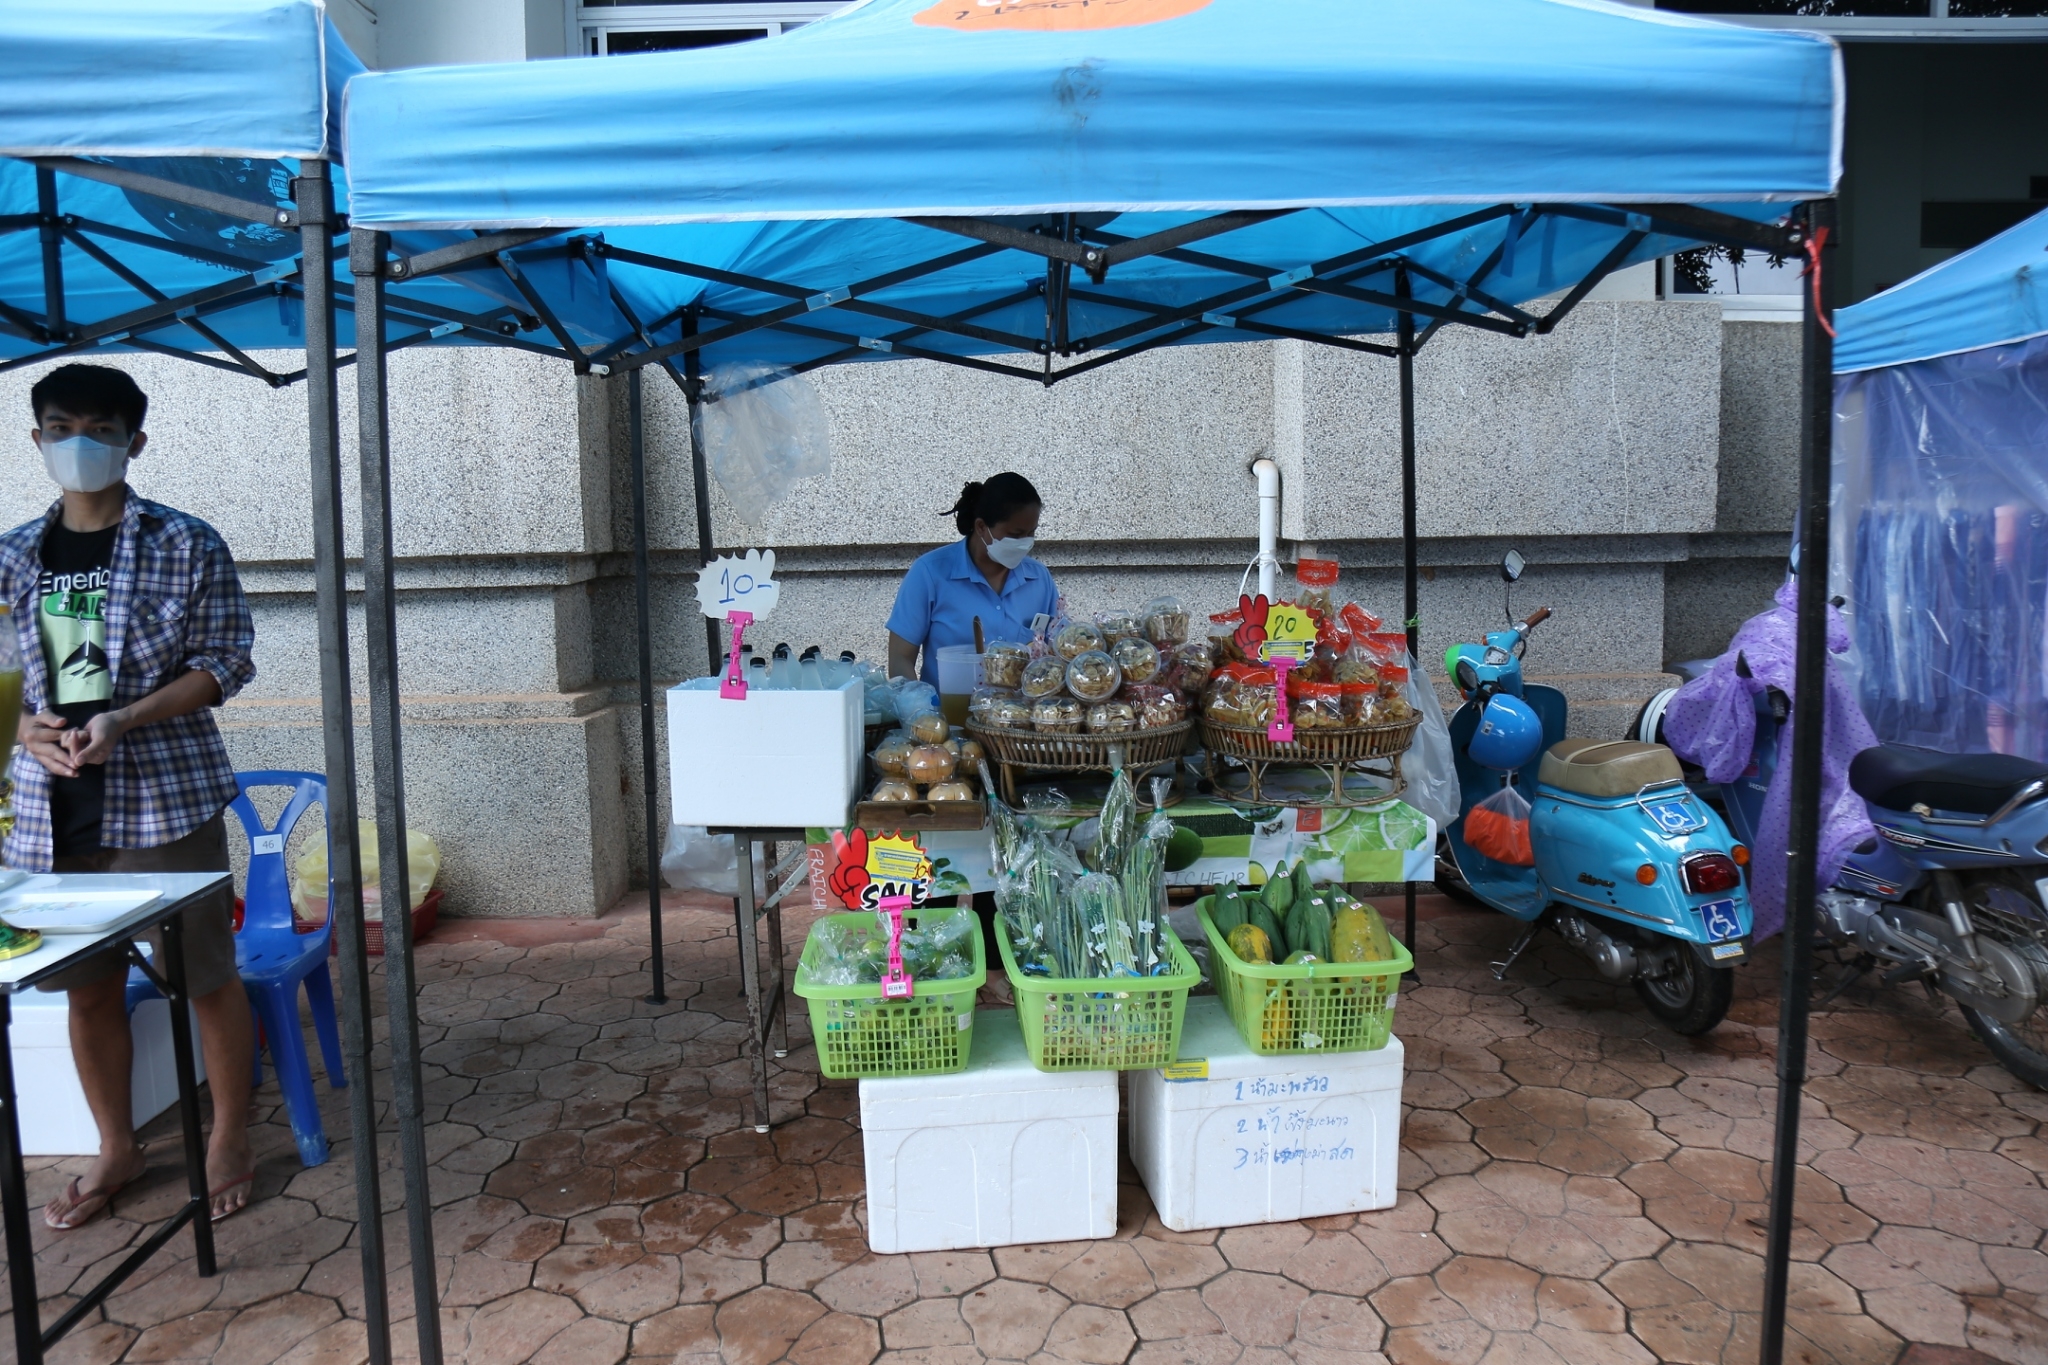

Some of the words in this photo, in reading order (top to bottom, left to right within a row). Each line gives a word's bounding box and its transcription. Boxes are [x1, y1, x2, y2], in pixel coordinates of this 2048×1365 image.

[1273, 615, 1297, 640] 20
[262, 840, 275, 849] 46
[861, 878, 928, 911] SALE
[1235, 1081, 1245, 1100] 1
[1236, 1118, 1248, 1134] 2
[1234, 1148, 1249, 1170] 3
